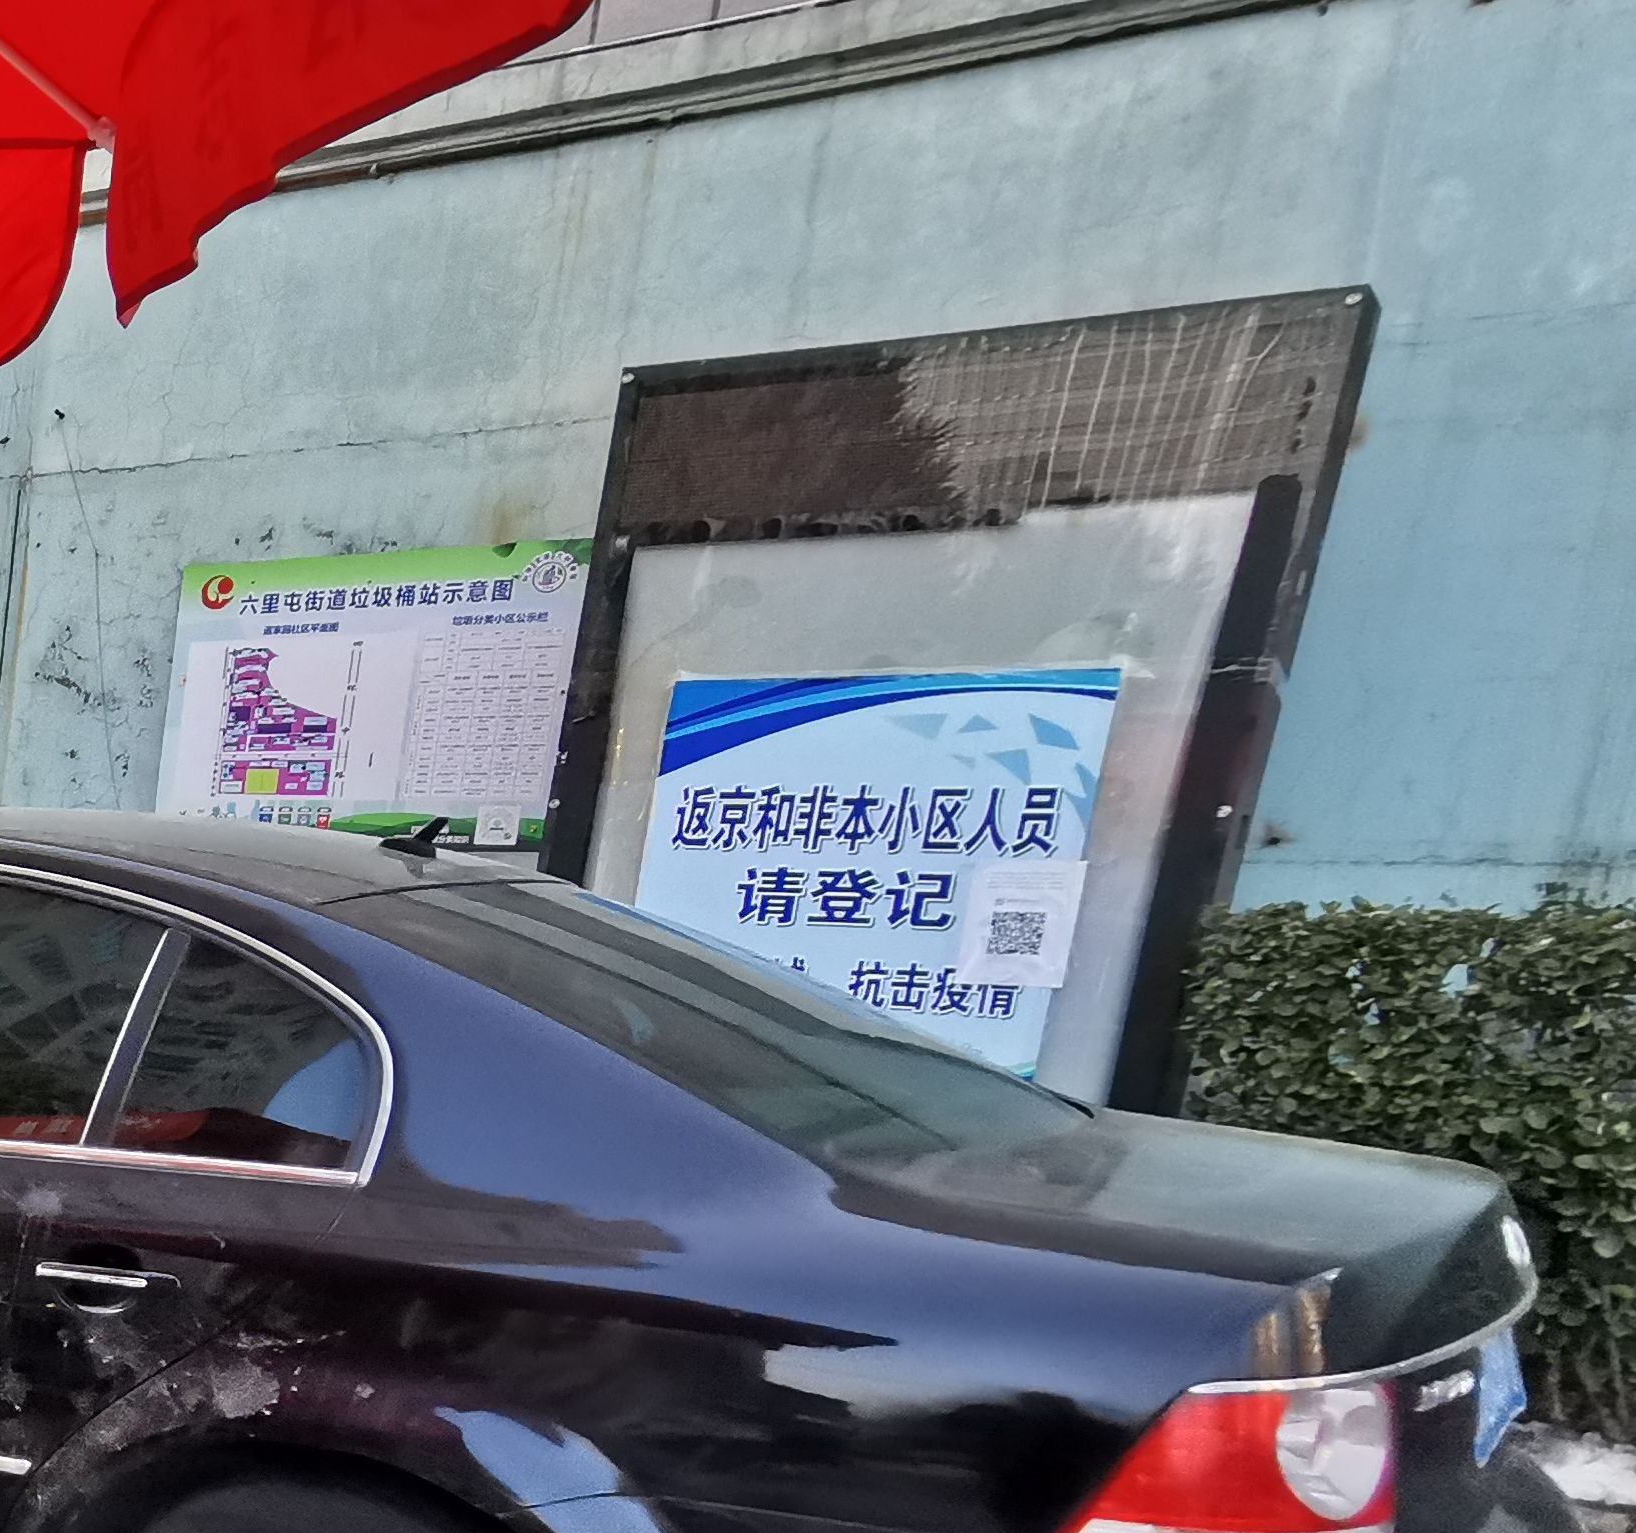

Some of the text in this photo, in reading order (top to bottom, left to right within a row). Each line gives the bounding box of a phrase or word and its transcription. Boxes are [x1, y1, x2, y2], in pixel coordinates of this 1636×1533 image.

[240, 578, 514, 616] 六里屯街道垃圾桶站示意图
[671, 785, 1061, 857] 返京和非本小区人员
[736, 867, 956, 931] 请登记
